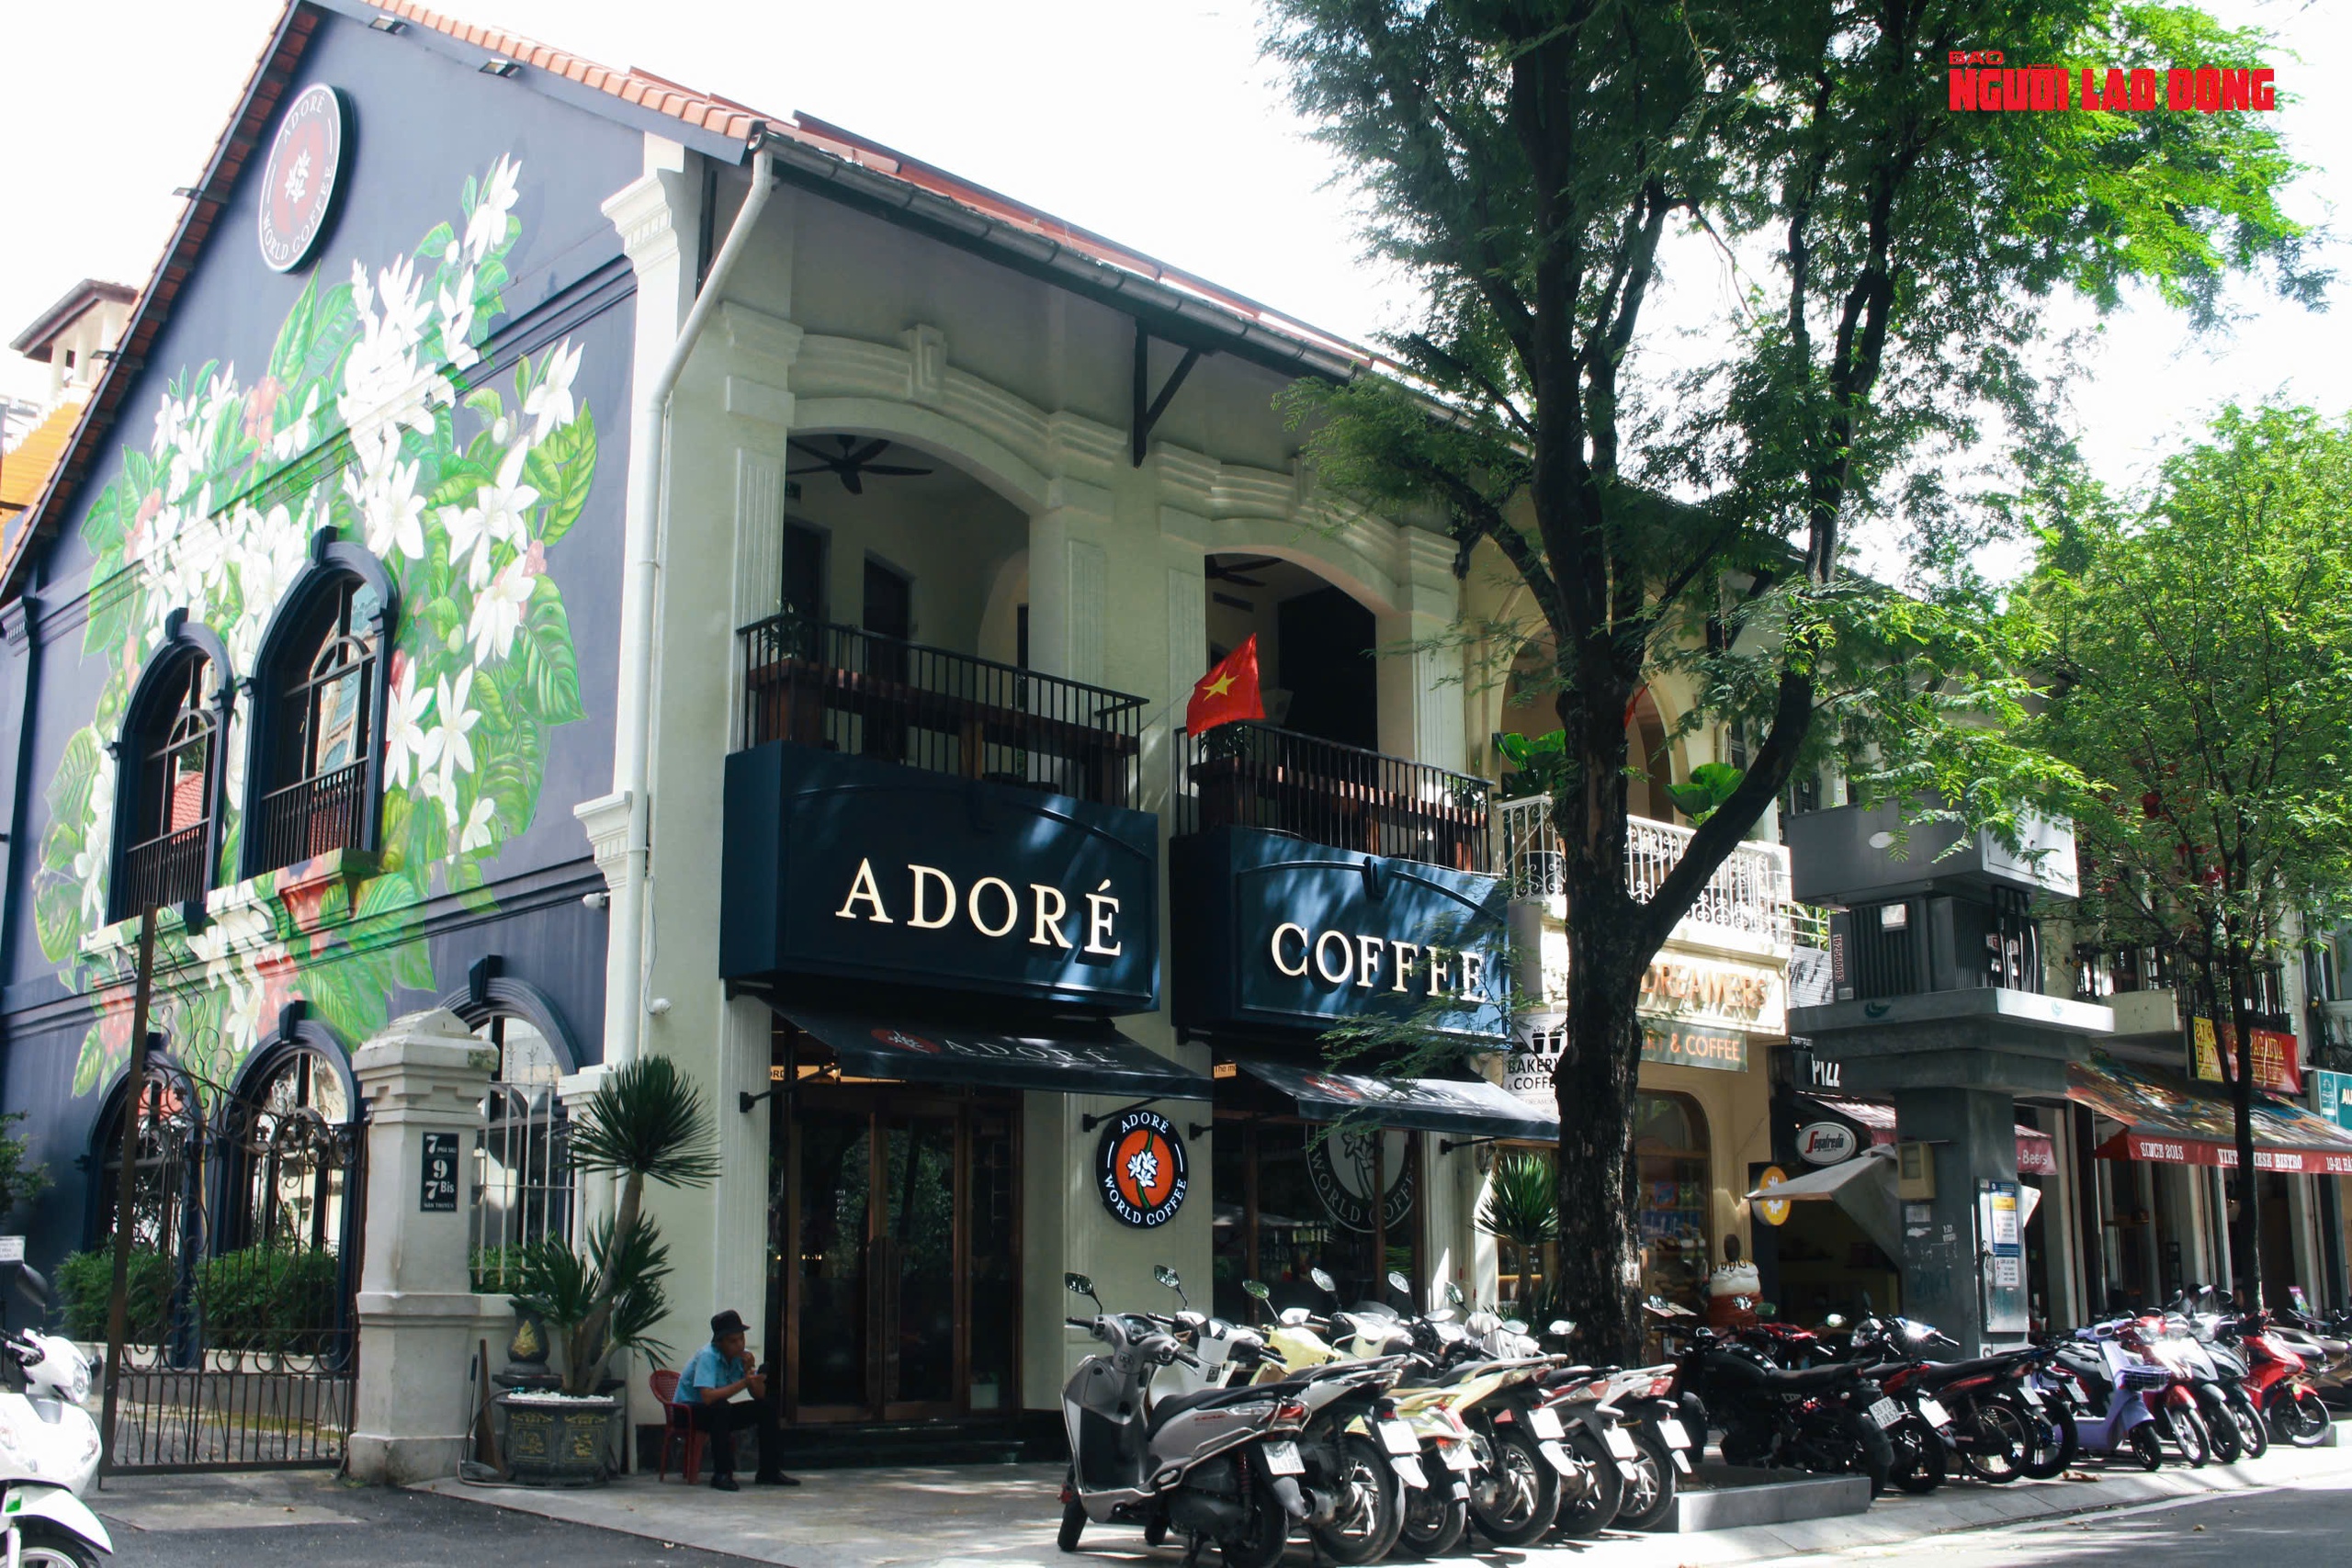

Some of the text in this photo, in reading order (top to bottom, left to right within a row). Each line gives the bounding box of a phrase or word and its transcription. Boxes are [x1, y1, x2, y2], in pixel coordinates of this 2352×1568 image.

[263, 165, 334, 261] WORLD COFFEE
[835, 856, 1122, 957] ADORÉ
[1271, 921, 1487, 1004] COFFEE
[1685, 1034, 1742, 1062] COFFEE
[1122, 1112, 1170, 1134] ADORÉ
[426, 1134, 439, 1155] 7
[2140, 1142, 2184, 1160] SINCE 2013
[2022, 1149, 2048, 1165] Beers
[2275, 1153, 2302, 1169] BISTRO
[433, 1159, 448, 1179] 9
[424, 1180, 455, 1200] 7 Bis
[1311, 1151, 1361, 1223] WORLD
[1104, 1173, 1187, 1225] WORLD COFFEE
